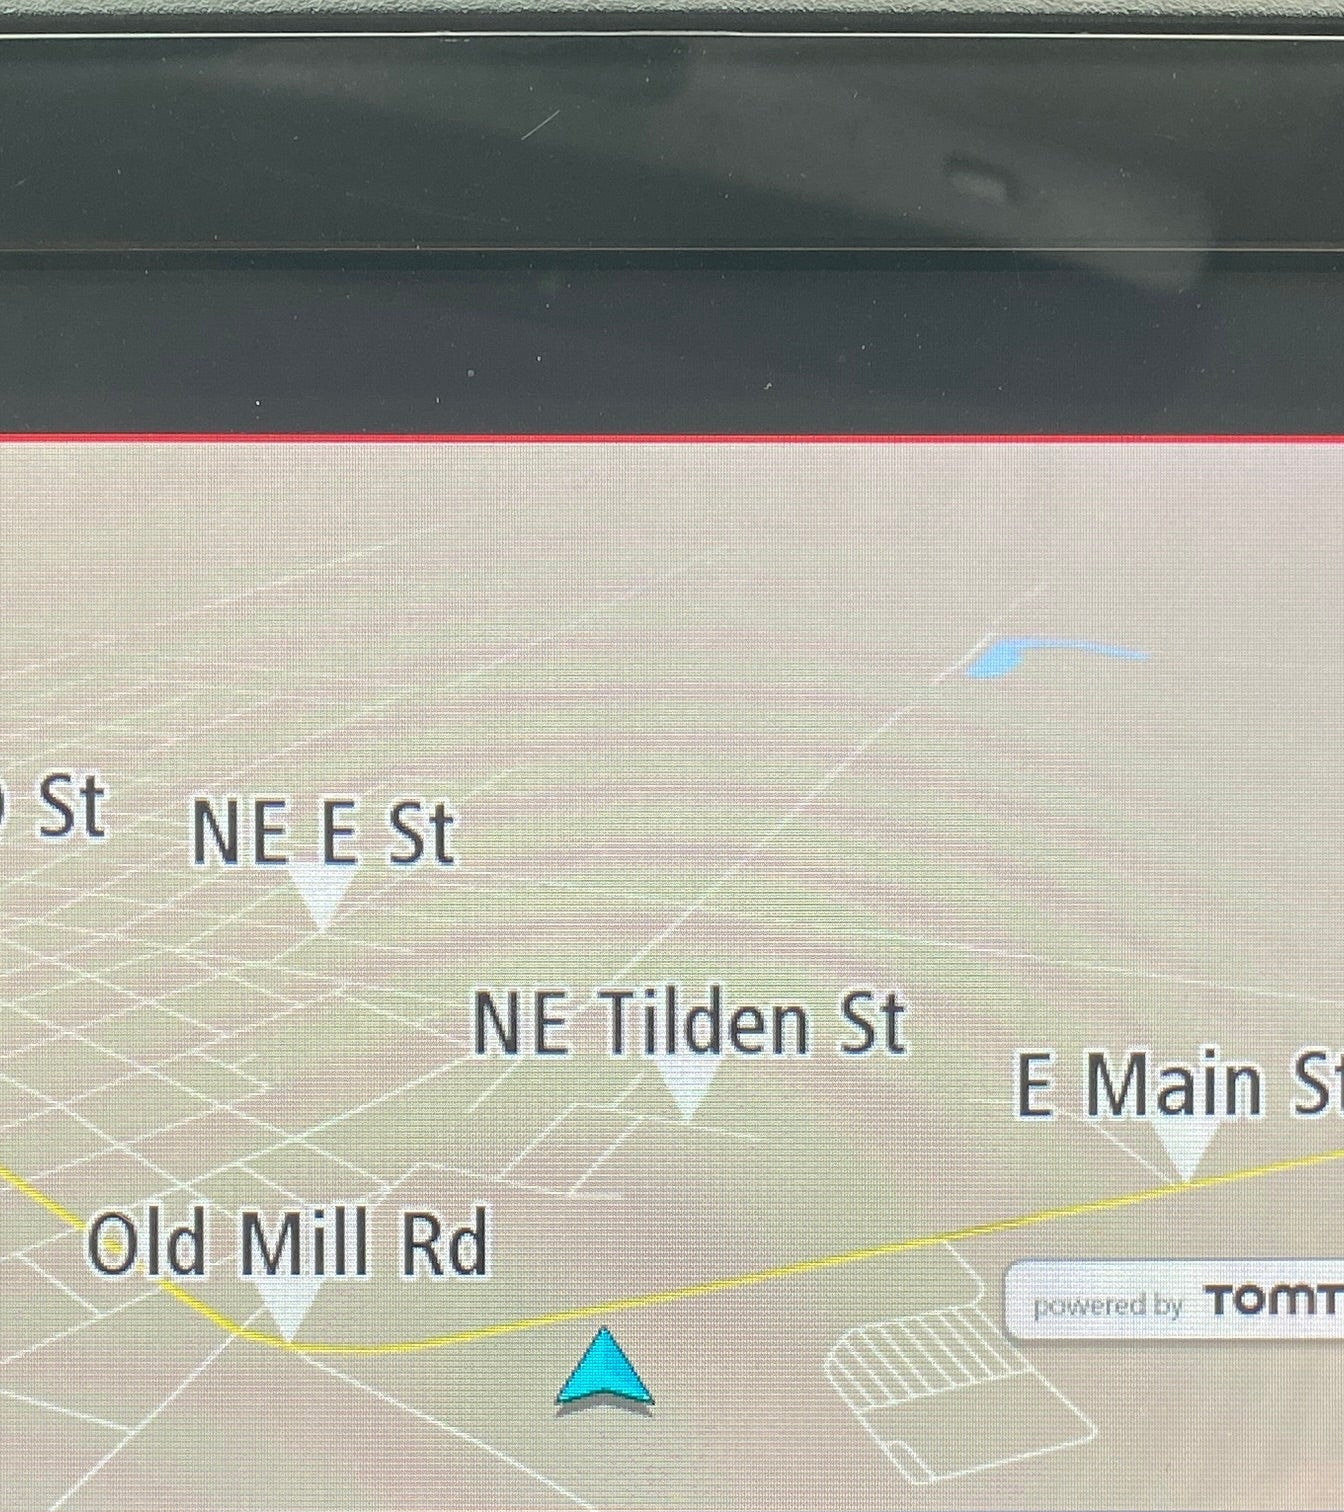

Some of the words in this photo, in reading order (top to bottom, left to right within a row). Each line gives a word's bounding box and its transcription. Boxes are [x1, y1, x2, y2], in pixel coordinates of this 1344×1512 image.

[40, 772, 105, 838] St
[194, 799, 289, 865] NE
[324, 800, 358, 866] E
[390, 801, 454, 866] St
[475, 991, 569, 1055] NE
[597, 985, 809, 1055] Tilden
[841, 990, 905, 1055] St
[1019, 1052, 1052, 1117] E
[1088, 1048, 1260, 1116] Main
[88, 1205, 205, 1276] Old
[242, 1206, 367, 1276] Mill
[404, 1206, 486, 1276] Rd
[1033, 1291, 1147, 1323] powered
[1153, 1291, 1184, 1322] by
